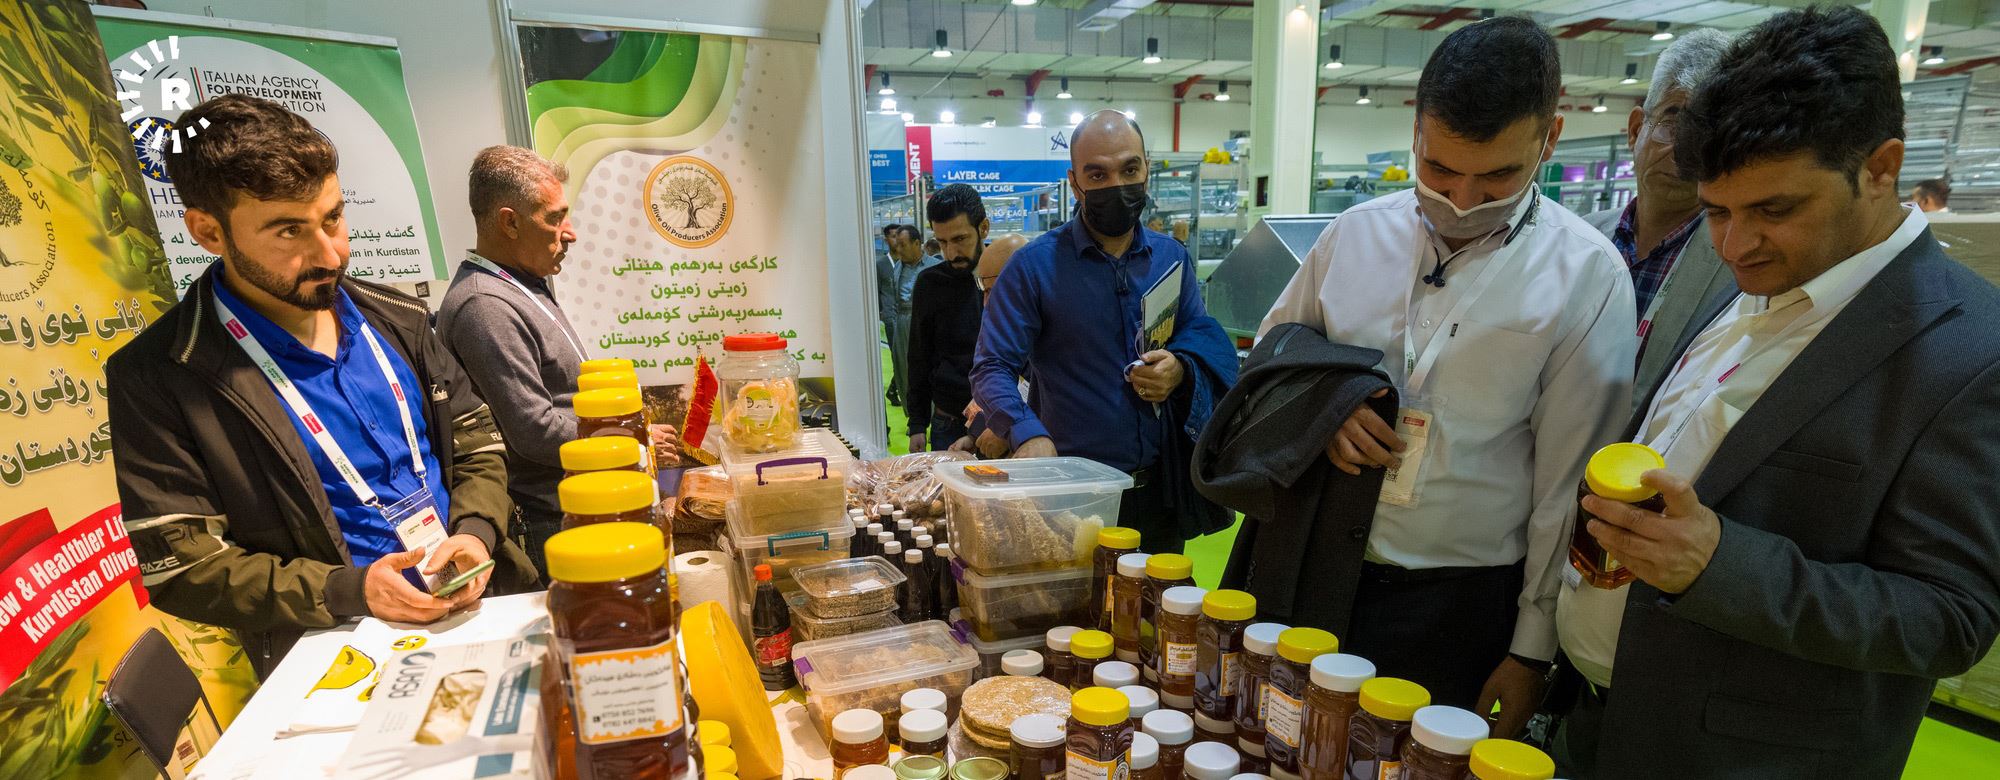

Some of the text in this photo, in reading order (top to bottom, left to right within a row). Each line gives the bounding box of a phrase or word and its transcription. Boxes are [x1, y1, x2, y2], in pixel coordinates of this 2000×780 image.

[203, 71, 319, 89] ITALIAN AGENCY
[207, 84, 322, 101] FOR DEVELOPMENT
[948, 170, 1000, 180] LAYER CAGE
[651, 202, 727, 240] Olive Oil Producers Association
[364, 249, 373, 257] in
[375, 247, 420, 257] Kurdistan
[389, 263, 421, 278] تنمية
[670, 259, 723, 277] بەرهەم
[729, 257, 778, 274] کارگەی
[650, 282, 748, 299] زەیتی زەیتون
[599, 331, 671, 349] کوردستان
[15, 576, 37, 601] &
[28, 527, 105, 590] Healthier
[20, 547, 139, 644] Kurdistan Olive
